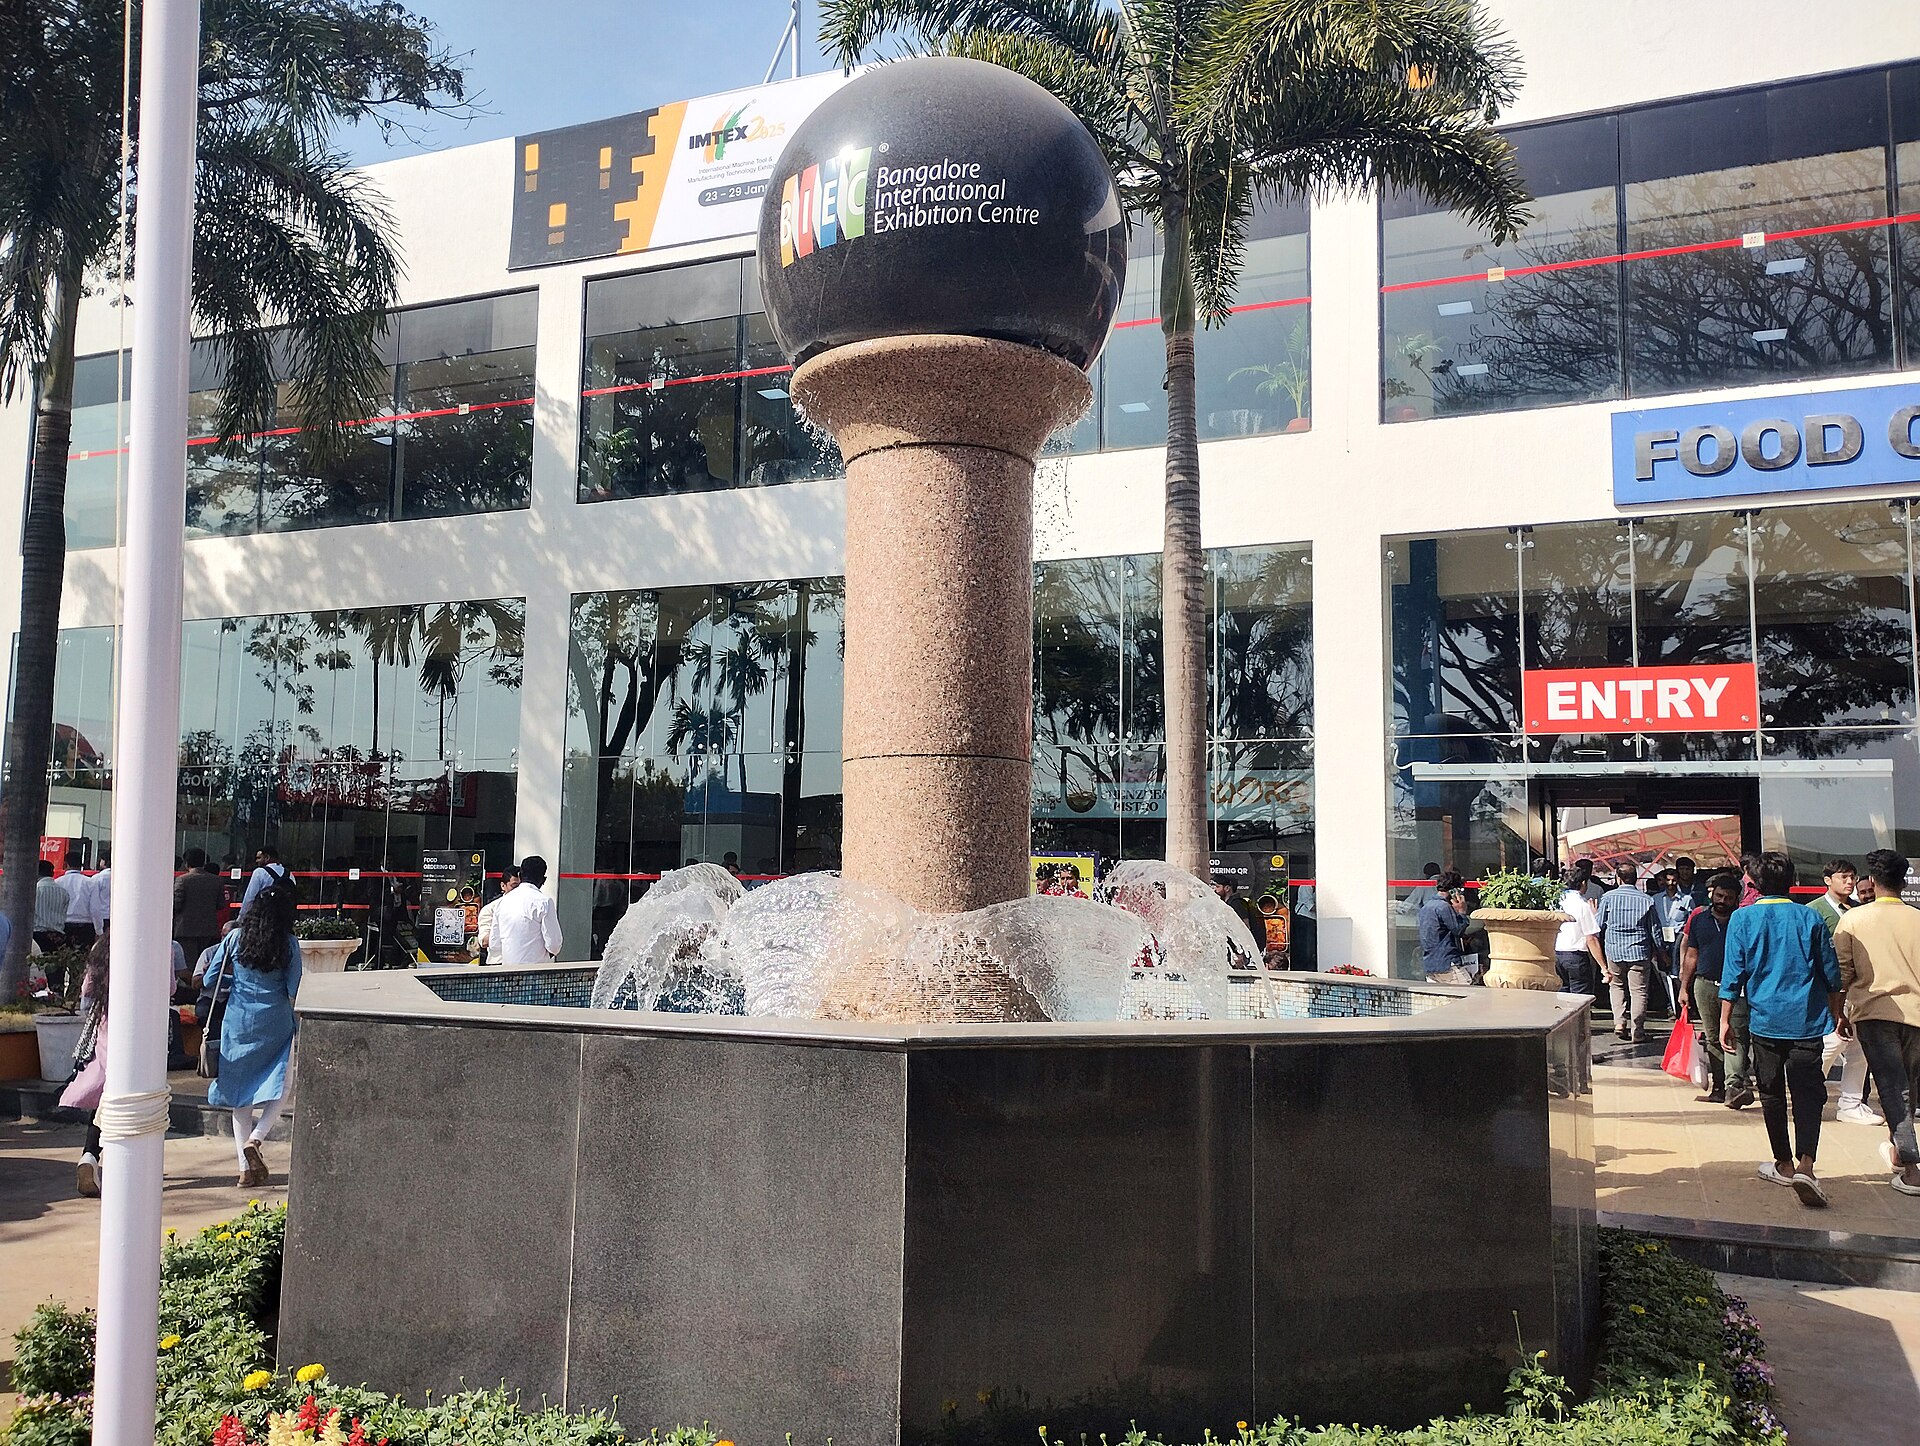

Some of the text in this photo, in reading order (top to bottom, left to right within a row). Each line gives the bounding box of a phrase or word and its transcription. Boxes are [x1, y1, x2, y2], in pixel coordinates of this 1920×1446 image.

[689, 115, 785, 149] IMTEX 2025
[687, 173, 725, 183] Manufacturing
[726, 168, 757, 177] Technology
[698, 164, 731, 174] International
[732, 160, 755, 168] Machine
[876, 158, 981, 188] Bangalore
[705, 191, 718, 202] 23
[728, 187, 742, 198] 29
[780, 169, 867, 248] BIEC
[875, 179, 1006, 210] International
[874, 202, 1040, 234] Exhibition Centre
[1634, 414, 1864, 481] FOOD
[1547, 677, 1730, 721] ENTRY
[1237, 867, 1248, 875] QR
